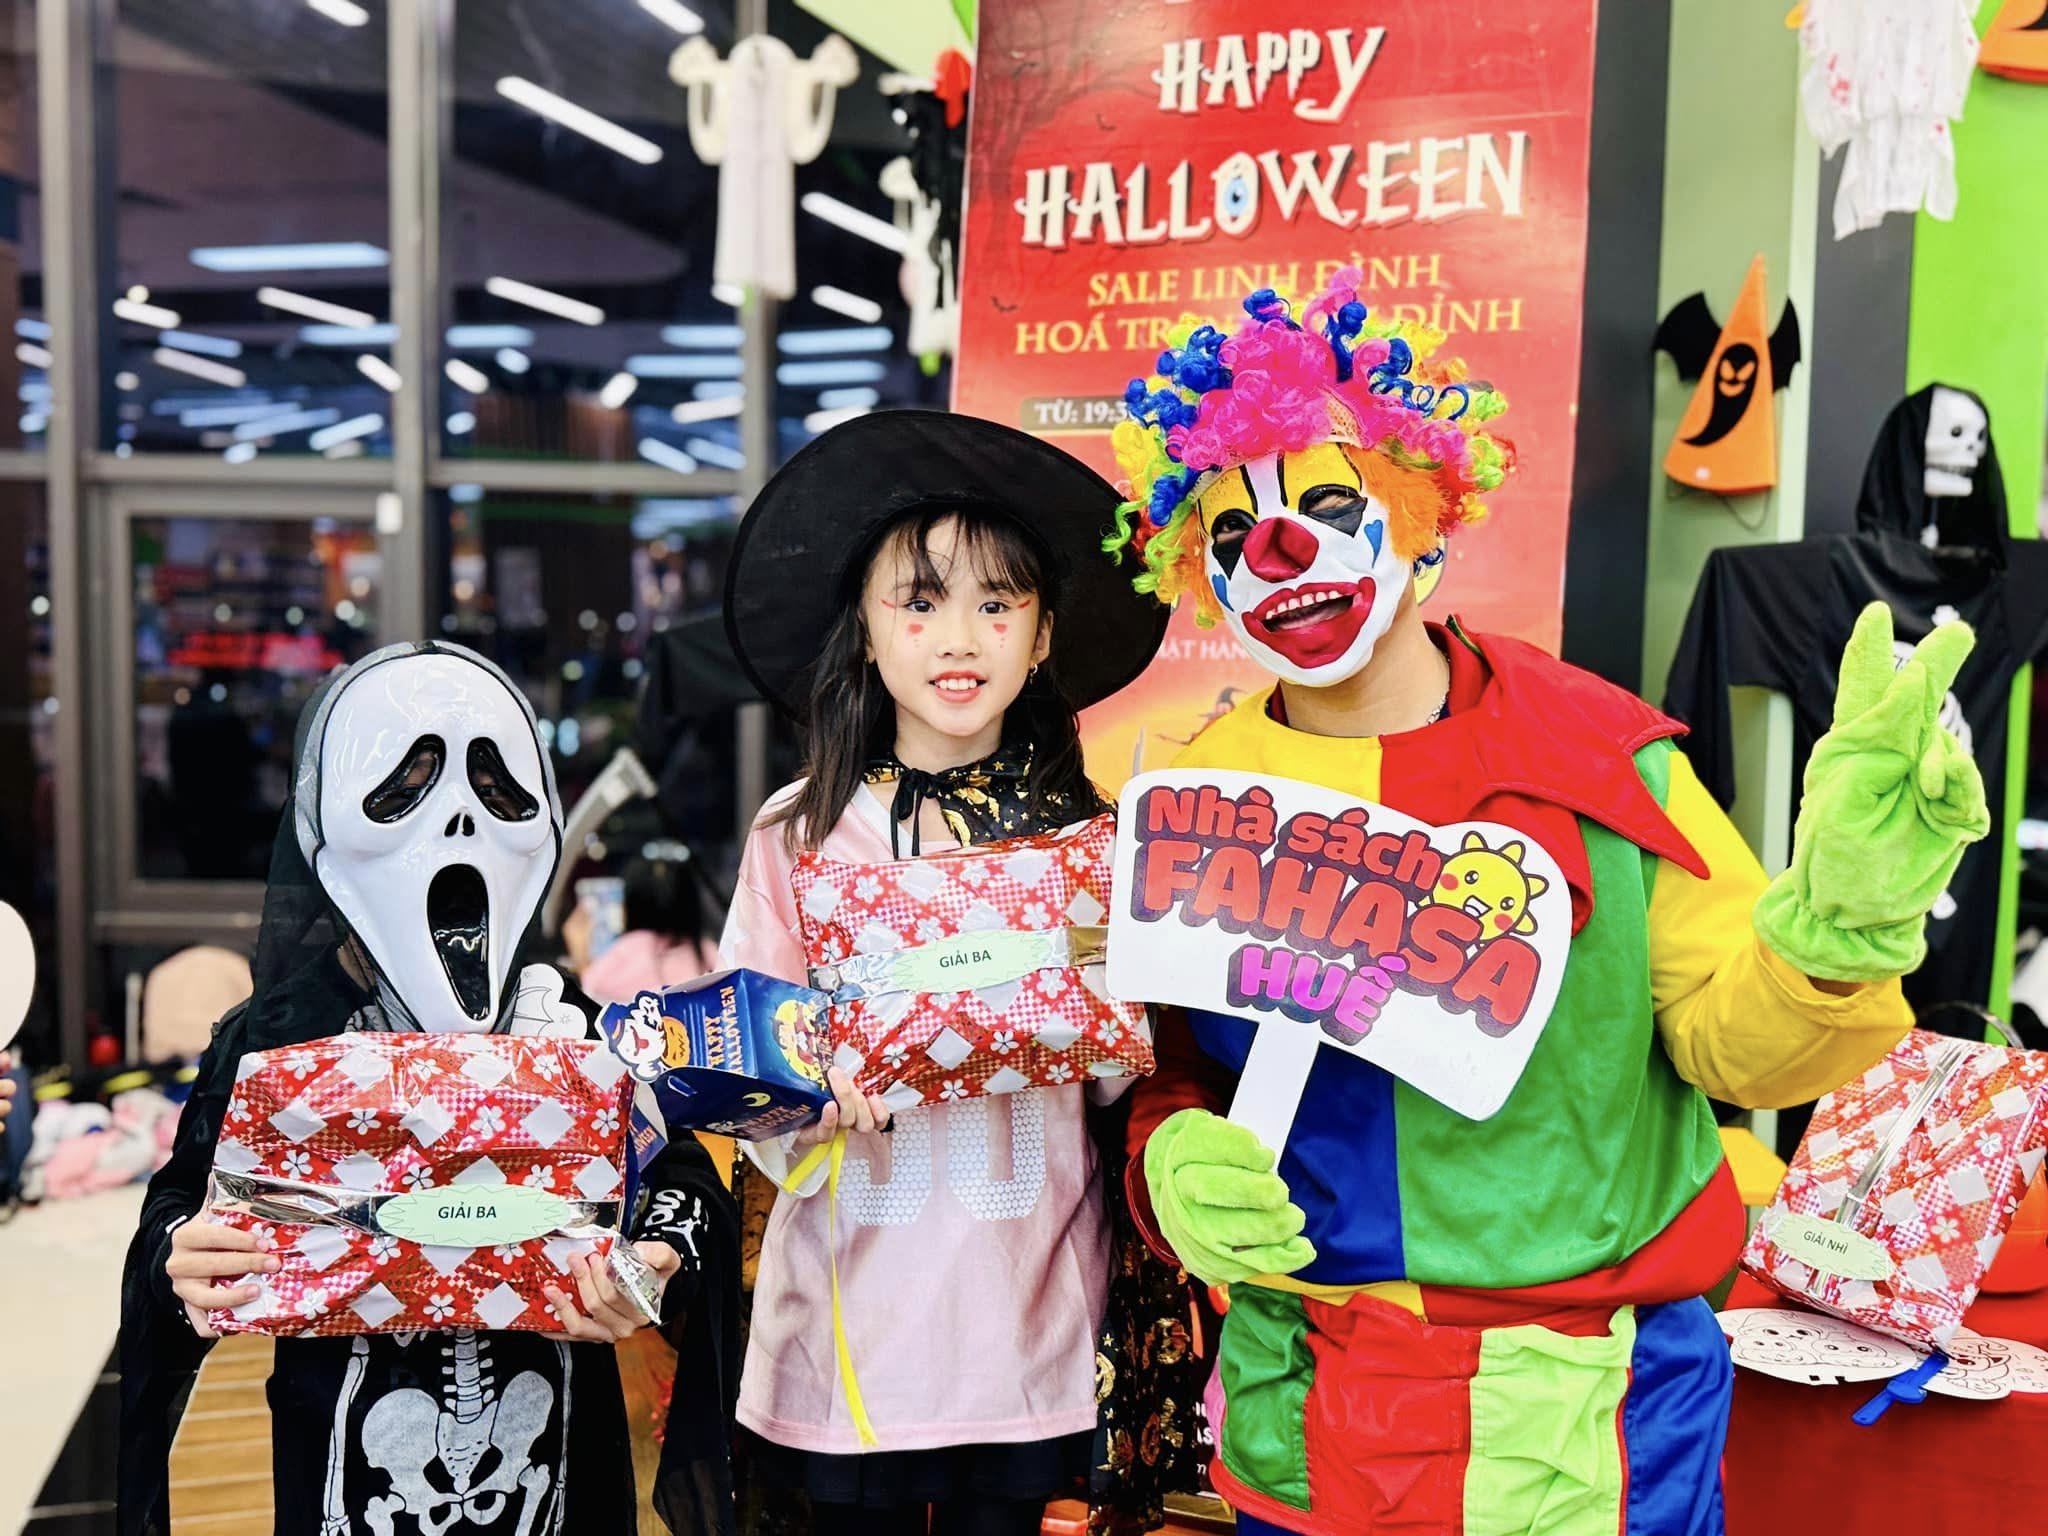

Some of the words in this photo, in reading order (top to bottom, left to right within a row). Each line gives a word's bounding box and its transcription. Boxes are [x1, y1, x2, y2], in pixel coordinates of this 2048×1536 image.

[1150, 26, 1386, 123] HAPPY
[1014, 130, 1528, 249] HALLOWEEN
[1088, 269, 1180, 307] SALE
[1191, 261, 1300, 301] LINH
[1014, 312, 1110, 354] HOÁ
[1084, 401, 1134, 424] 19:3
[1142, 785, 1276, 848] Nhà
[1284, 806, 1443, 892] sách
[1135, 838, 1542, 1032] FAHASA
[939, 949, 969, 968] GIẢI
[972, 949, 992, 963] BA
[1234, 952, 1408, 1040] HUẾ
[438, 1201, 471, 1219] GIẢI
[476, 1205, 496, 1219] BA
[1803, 1230, 1826, 1247] GIẢI
